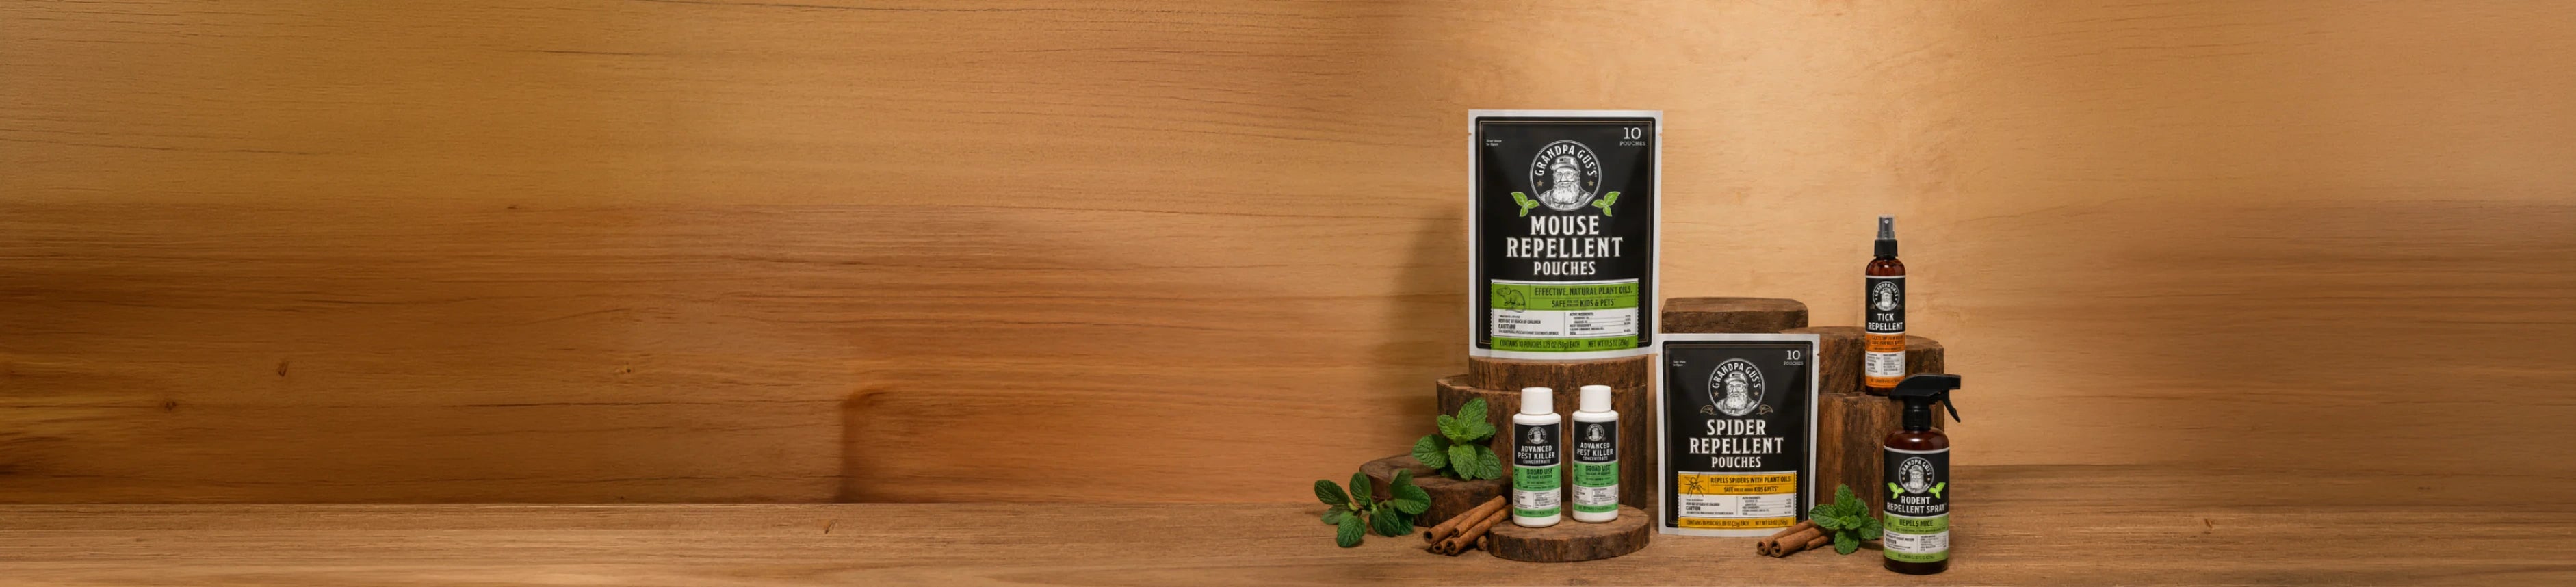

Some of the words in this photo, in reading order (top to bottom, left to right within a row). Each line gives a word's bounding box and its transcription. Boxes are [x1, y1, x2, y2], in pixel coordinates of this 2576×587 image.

[1624, 127, 1641, 140] 10
[1534, 144, 1574, 177] GRANDPA
[1531, 216, 1600, 236] MOUSE
[1506, 237, 1623, 258] REPELLENT
[1533, 261, 1596, 276] POUCHES
[1868, 322, 1903, 331] REPELLENT
[1786, 350, 1801, 361] 10
[1712, 363, 1744, 389] GRANDPA
[1706, 419, 1767, 436] SPIDER
[1592, 448, 1613, 456] KILLER
[1689, 437, 1784, 454] REPELLENT
[1711, 456, 1762, 468] POUCHES
[1901, 459, 1921, 475] GRANDPA
[1901, 495, 1931, 505] RODENT
[1887, 501, 1925, 514] REPELLENT
[1926, 504, 1945, 513] SPRAY
[1899, 519, 1919, 527] REPELS
